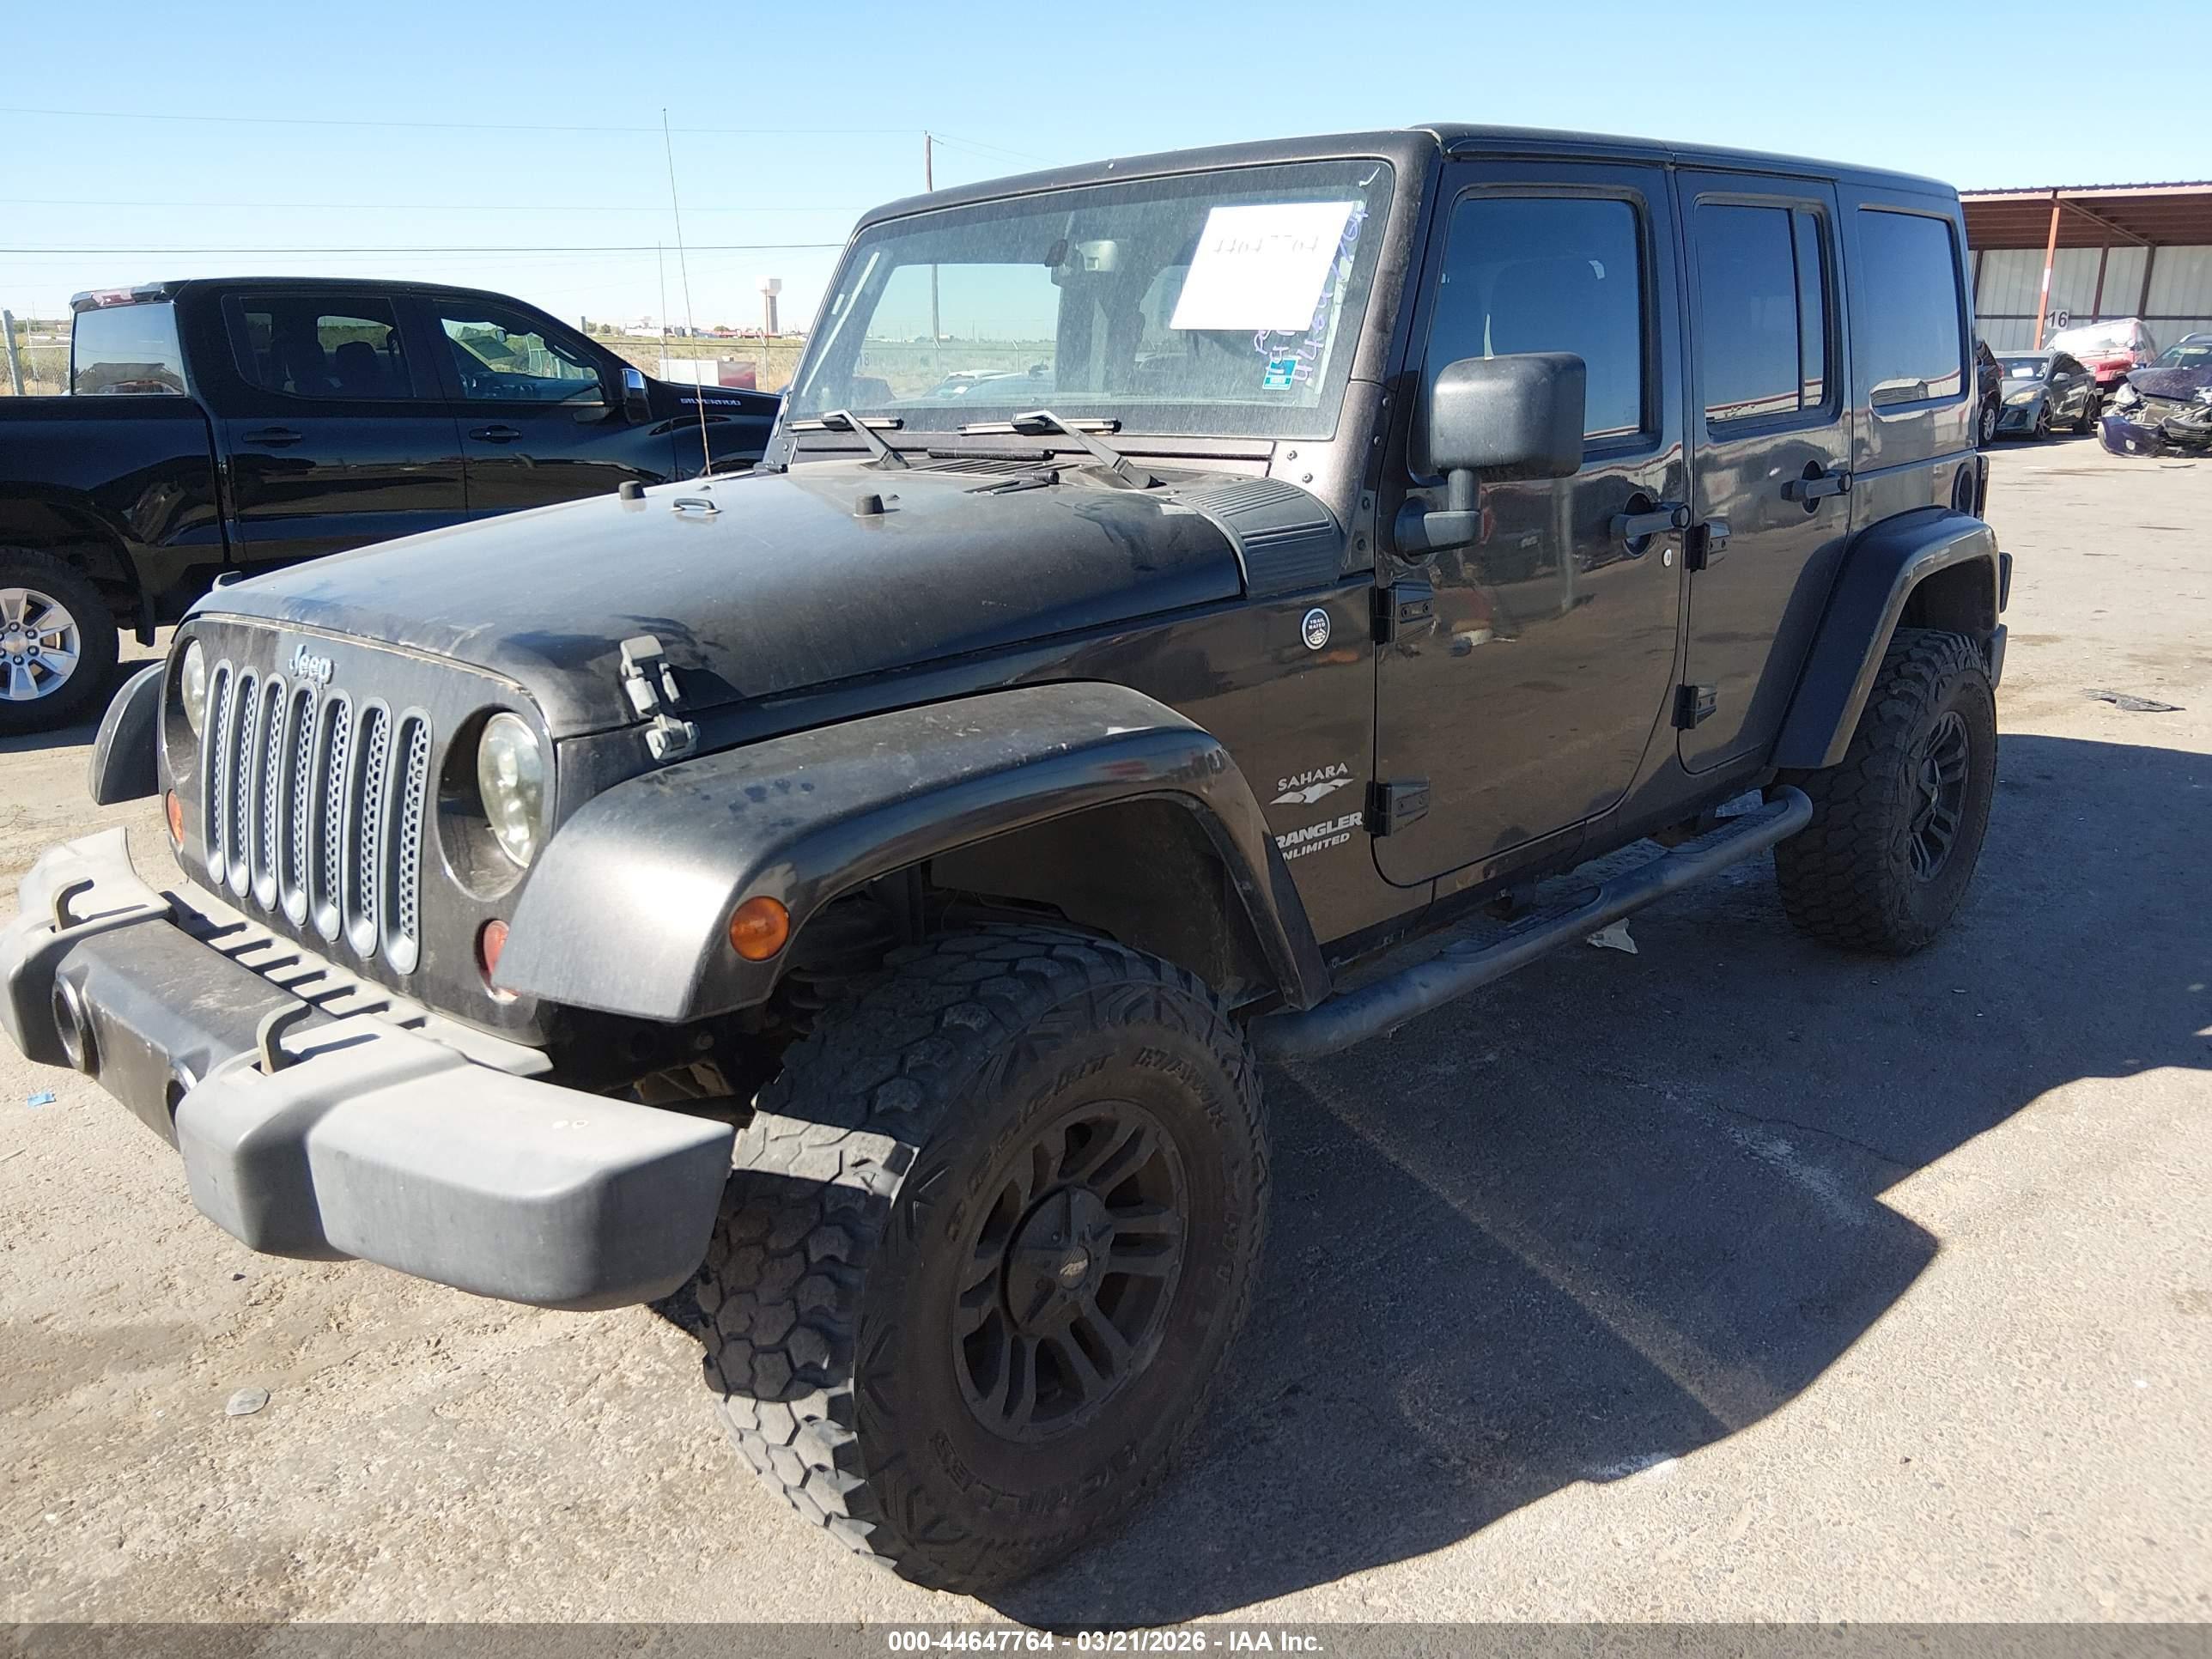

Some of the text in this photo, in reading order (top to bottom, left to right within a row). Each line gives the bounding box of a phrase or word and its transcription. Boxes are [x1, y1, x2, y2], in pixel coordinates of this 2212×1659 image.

[2048, 311, 2068, 328] 16
[680, 398, 742, 406] SILVERADO
[1308, 622, 1326, 630] RATED
[288, 643, 334, 690] Jeep
[1277, 762, 1348, 792] SAHARA
[1274, 811, 1364, 849] RANGLER
[1282, 832, 1351, 861] NLIMITED
